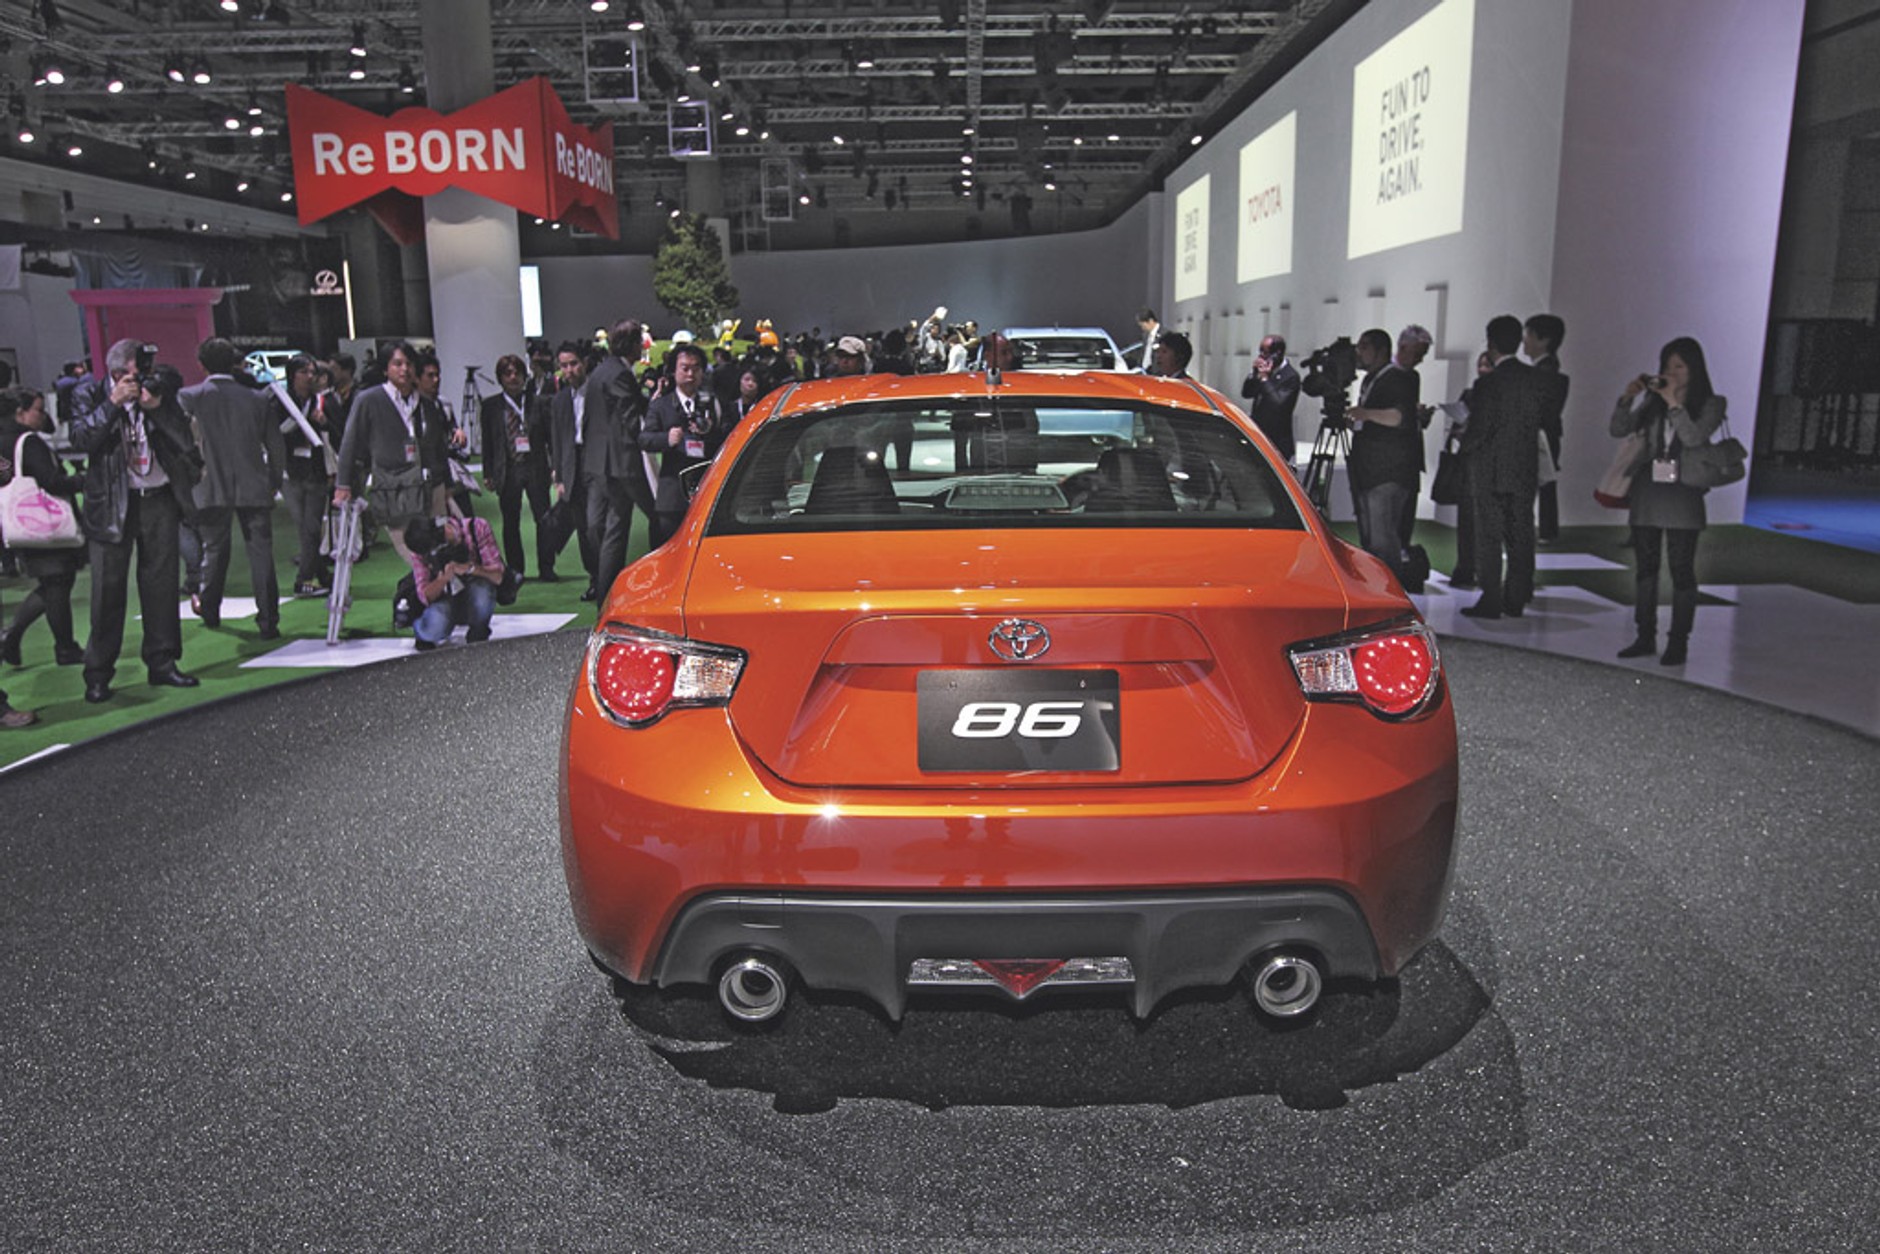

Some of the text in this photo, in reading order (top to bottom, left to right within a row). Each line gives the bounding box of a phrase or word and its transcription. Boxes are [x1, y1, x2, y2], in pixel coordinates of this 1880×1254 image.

[1381, 65, 1430, 125] FUN TO
[312, 127, 527, 175] Re BORN
[556, 131, 614, 195] Re BORN
[1247, 184, 1282, 225] TOYOTA
[1376, 156, 1423, 205] AGAIN.
[951, 702, 1084, 738] 86
